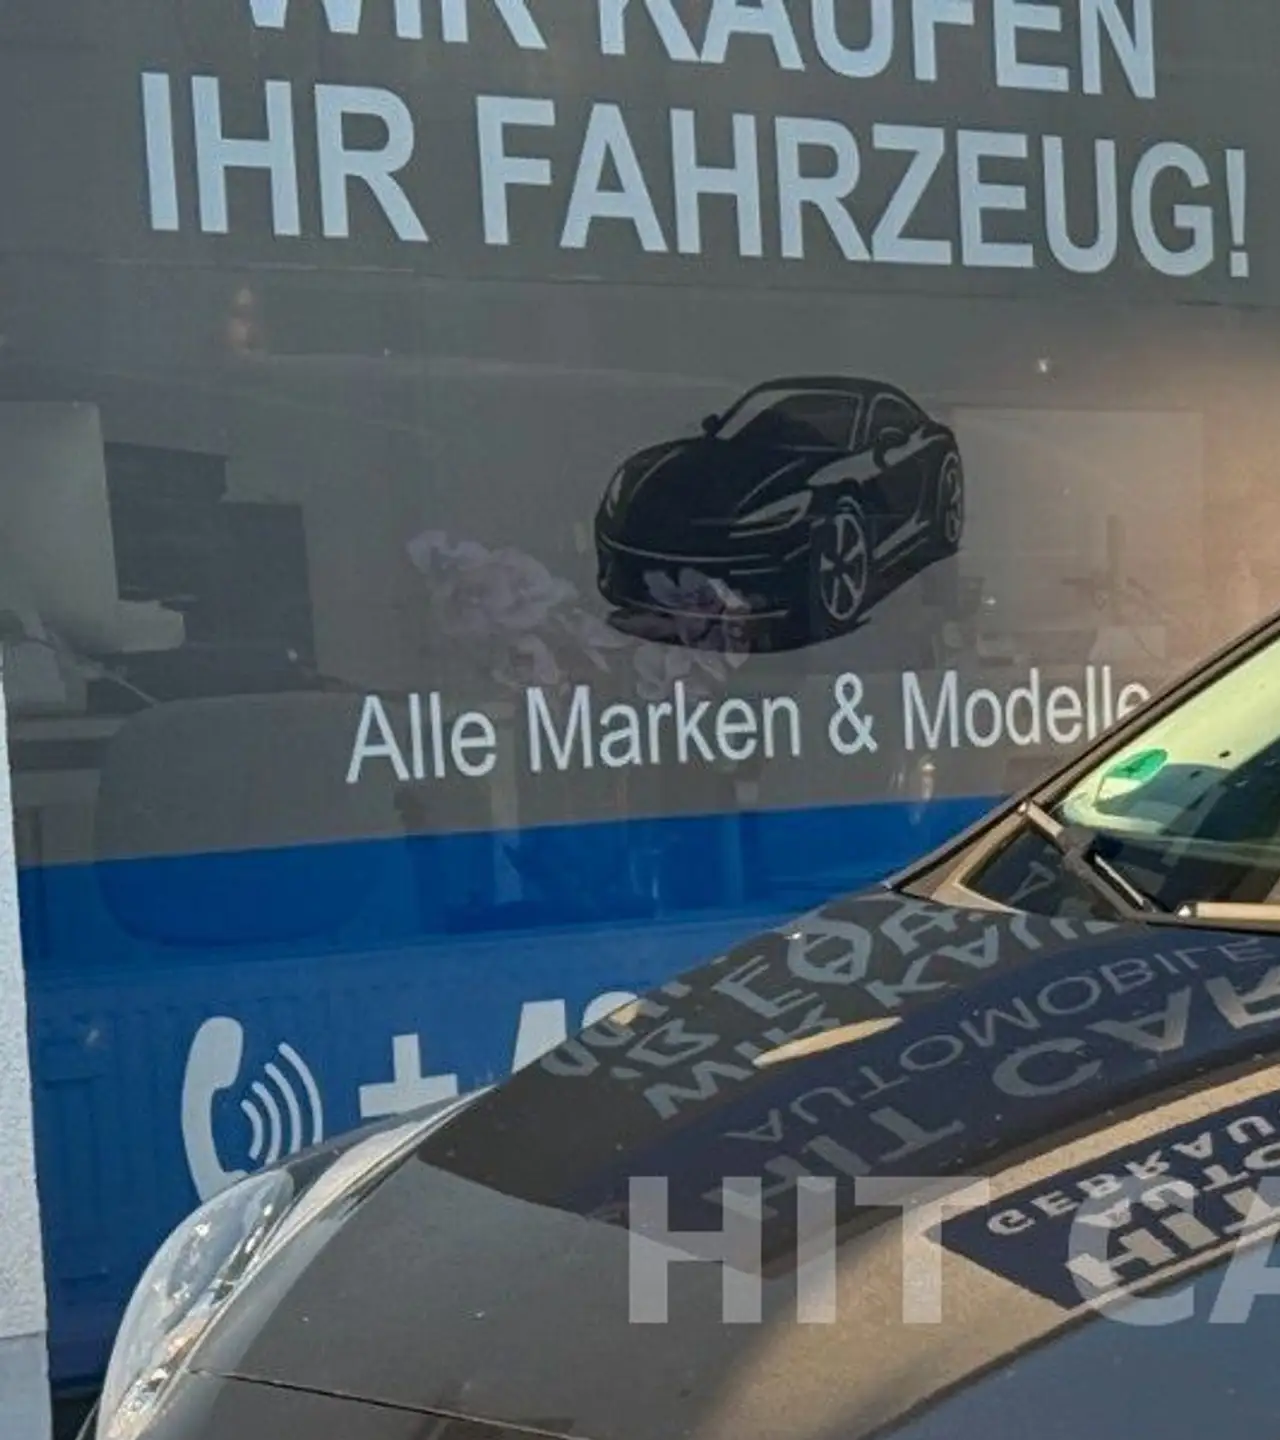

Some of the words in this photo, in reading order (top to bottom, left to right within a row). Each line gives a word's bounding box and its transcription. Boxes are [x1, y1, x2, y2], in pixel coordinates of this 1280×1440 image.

[140, 72, 429, 242] IHR
[476, 94, 1249, 278] FAHRZEUG!
[345, 691, 497, 784] Alle
[525, 680, 801, 773] Marken
[828, 671, 879, 754] &
